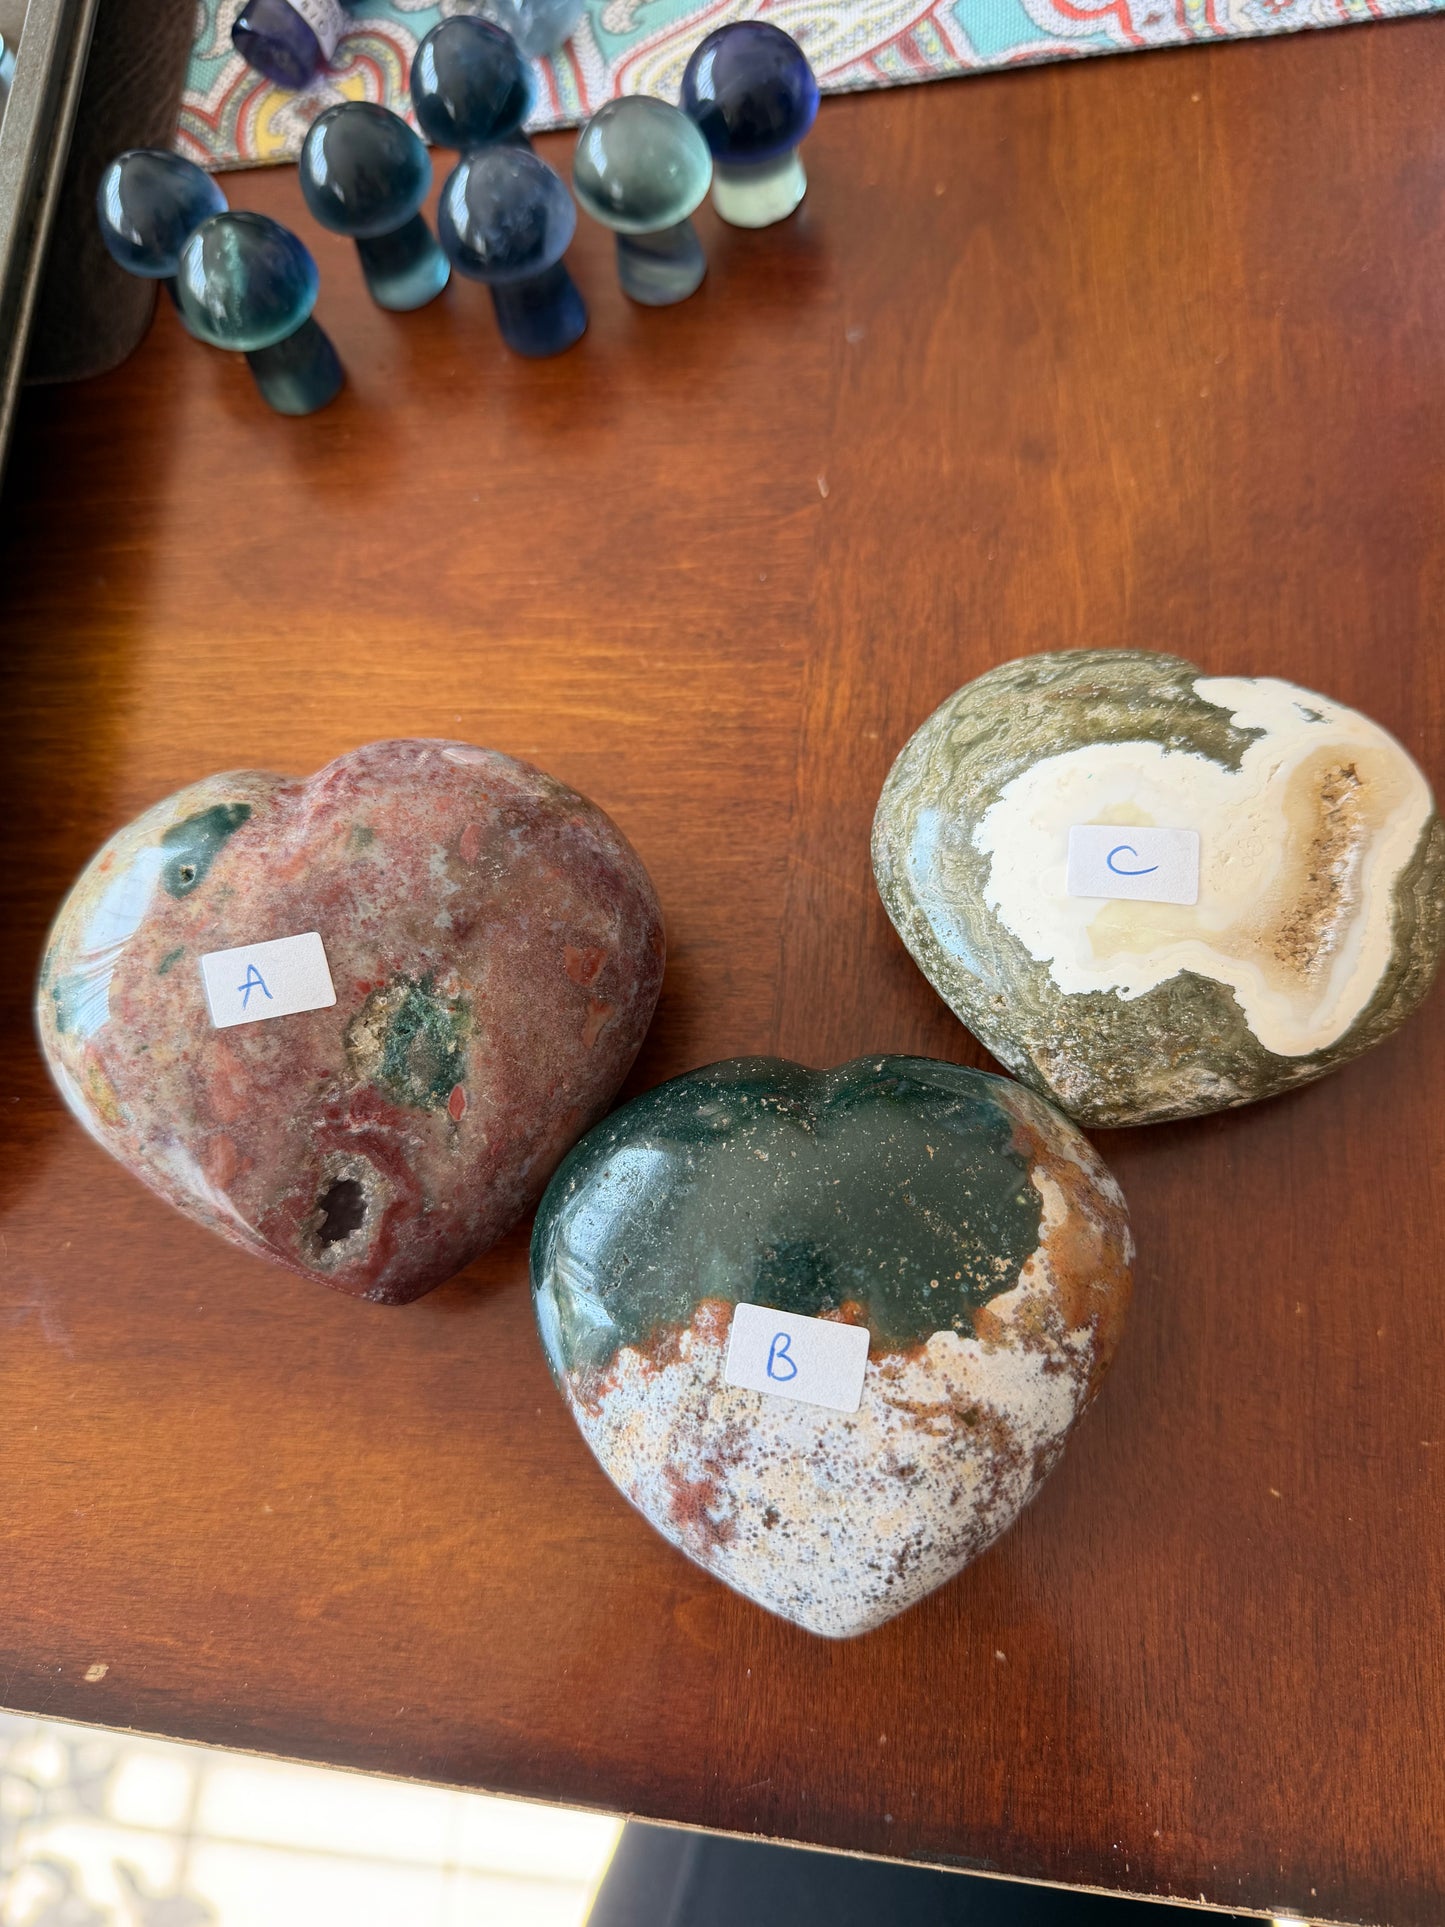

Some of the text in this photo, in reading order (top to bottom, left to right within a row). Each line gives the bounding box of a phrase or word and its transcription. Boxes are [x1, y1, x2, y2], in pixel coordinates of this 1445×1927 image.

[1106, 844, 1159, 877] C
[237, 964, 273, 1010] A
[766, 1332, 798, 1382] B
